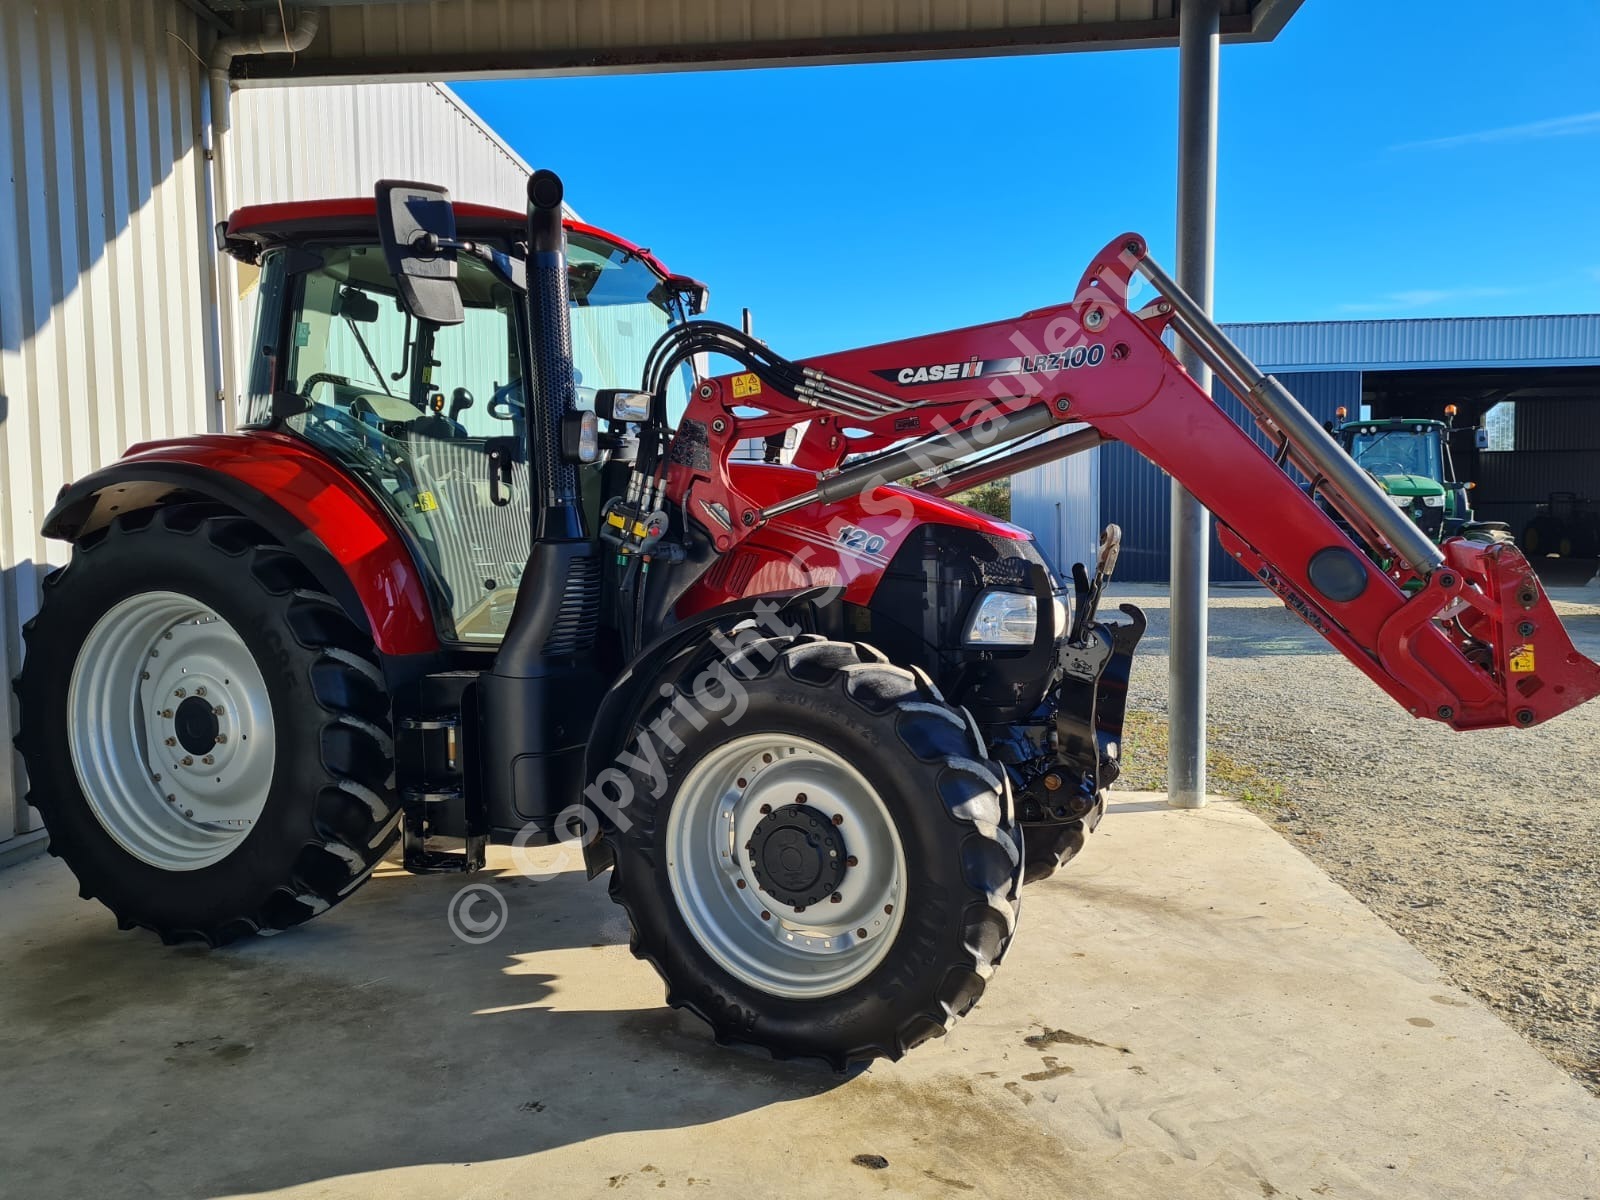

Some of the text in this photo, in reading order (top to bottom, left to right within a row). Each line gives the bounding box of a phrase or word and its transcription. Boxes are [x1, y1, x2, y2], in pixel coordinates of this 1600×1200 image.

[897, 355, 984, 385] CASE IH
[1021, 344, 1105, 374] LRZ100
[837, 525, 886, 554] 120
